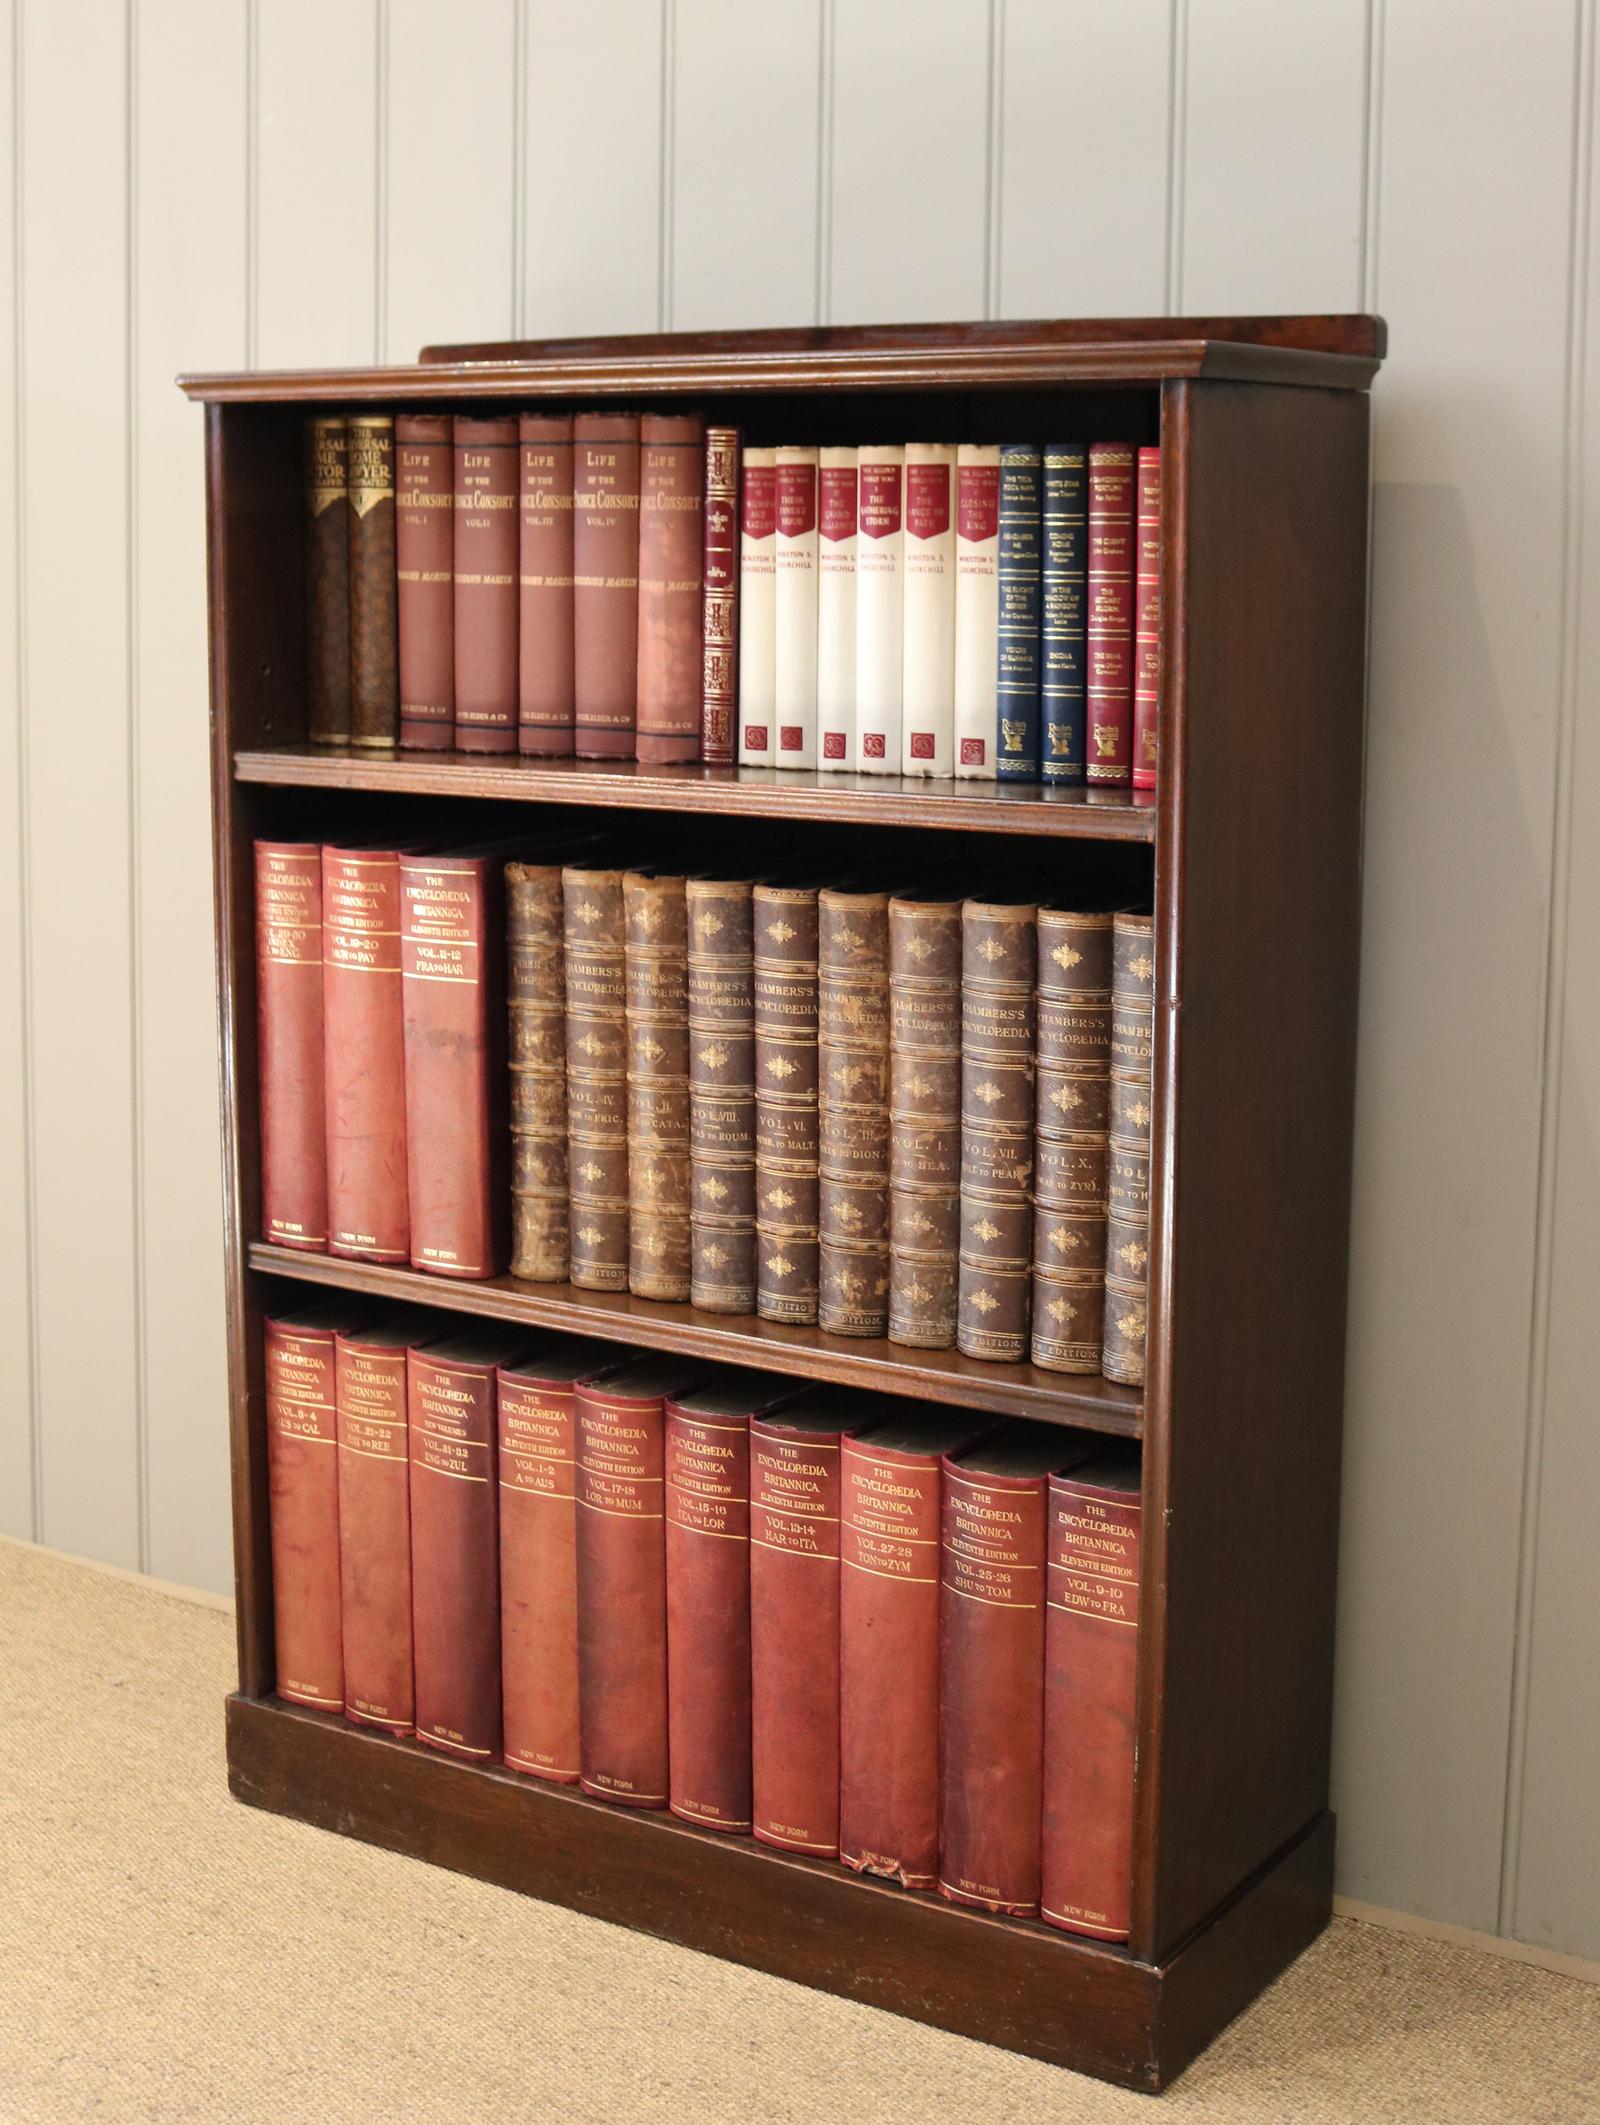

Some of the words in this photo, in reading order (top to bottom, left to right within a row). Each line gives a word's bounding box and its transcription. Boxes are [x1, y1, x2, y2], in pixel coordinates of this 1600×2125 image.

[424, 876, 443, 886] THE
[435, 1374, 451, 1386] THE
[522, 1394, 540, 1404] THE
[600, 1412, 618, 1422] THE
[508, 1418, 560, 1438] BRITANNICA
[689, 1428, 706, 1439] THE
[586, 1436, 640, 1456] BRITANNICA
[779, 1448, 798, 1458] THE
[449, 1458, 468, 1472] ZUL
[873, 1467, 893, 1479] THE
[534, 1477, 554, 1489] AUS
[764, 1472, 820, 1493] BRITANNICA
[616, 1496, 642, 1510] MUM
[857, 1492, 914, 1516] BRITANNICA
[972, 1492, 992, 1504] THE
[793, 1501, 825, 1512] EDITION
[1086, 1505, 1106, 1516] THE
[703, 1516, 726, 1530] LOR
[887, 1524, 918, 1536] EDITION
[956, 1516, 1014, 1540] BRITANNICA
[764, 1530, 787, 1544] HAR
[800, 1536, 818, 1551] ITA
[1064, 1532, 1128, 1556] BRITANNICA
[986, 1548, 1018, 1561] EDITION
[858, 1551, 878, 1566] TON
[888, 1560, 912, 1573] ZYM
[1060, 1554, 1100, 1572] ELEVENTH
[1100, 1562, 1134, 1577] EDITION
[954, 1576, 974, 1591] SHU
[986, 1584, 1012, 1599] TOM
[1064, 1591, 1090, 1607] EDW
[1102, 1600, 1126, 1616] FRA
